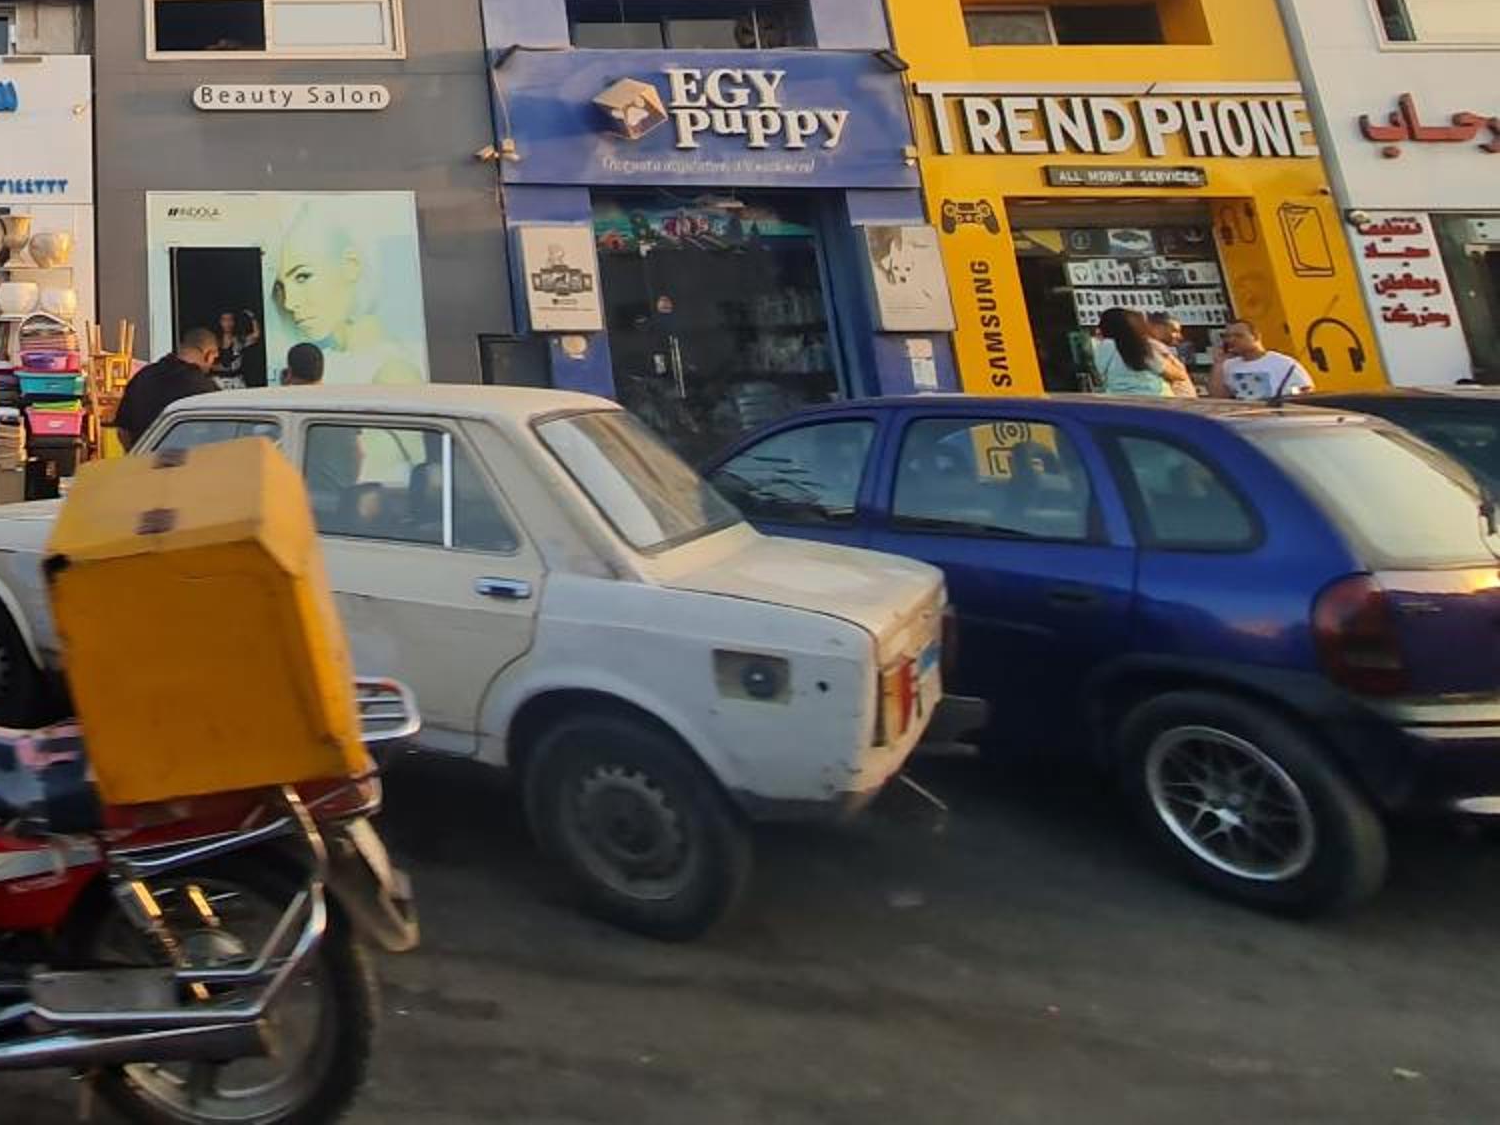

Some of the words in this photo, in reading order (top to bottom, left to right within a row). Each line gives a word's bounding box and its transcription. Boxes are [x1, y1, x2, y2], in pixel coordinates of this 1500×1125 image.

[200, 86, 293, 107] Beauty
[307, 86, 382, 104] Salon
[666, 68, 787, 108] EGY
[1058, 169, 1082, 182] ALL
[1088, 169, 1134, 182] MOBILE
[1139, 169, 1200, 182] SERVICES
[970, 260, 1013, 388] SAMSUNG
